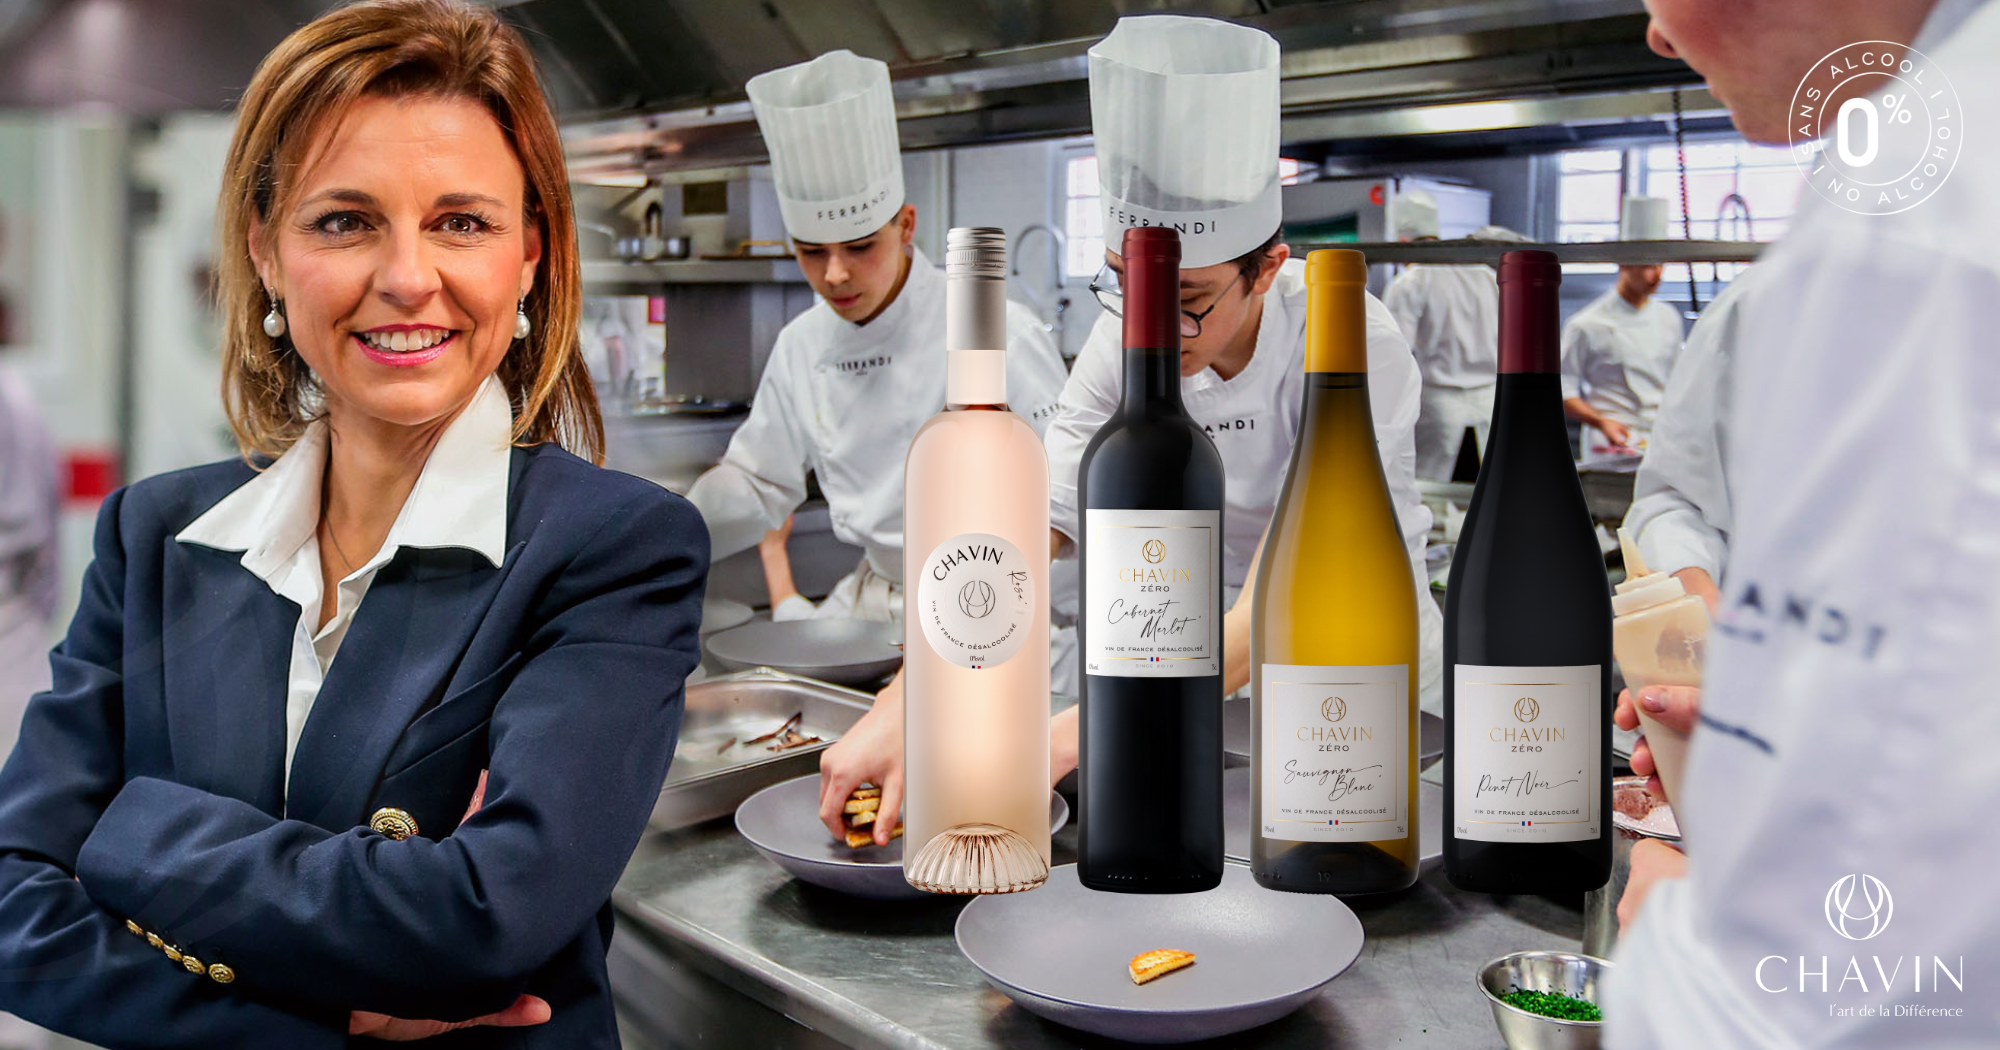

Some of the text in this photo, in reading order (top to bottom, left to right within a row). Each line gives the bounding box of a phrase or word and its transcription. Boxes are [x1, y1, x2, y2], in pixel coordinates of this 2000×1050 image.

[933, 545, 1004, 581] CHAVIN
[1118, 568, 1190, 583] CHAVIN
[1140, 584, 1170, 593] ZÉRO
[1107, 598, 1181, 625] Cabernet
[1140, 615, 1197, 642] Merlot
[940, 627, 965, 648] FRANCE
[1296, 726, 1373, 742] CHAVIN
[1488, 727, 1565, 742] CHAVIN
[1318, 743, 1350, 752] ZÉRO
[1511, 744, 1543, 752] ZÉRO
[1284, 759, 1383, 786] Sauvignon
[1328, 774, 1375, 801] Blanc
[1476, 770, 1578, 798] Pinot Noir
[1336, 807, 1387, 815] DÉSALCOOLISÉ
[1529, 808, 1580, 816] DÉSALCOOLISÉ
